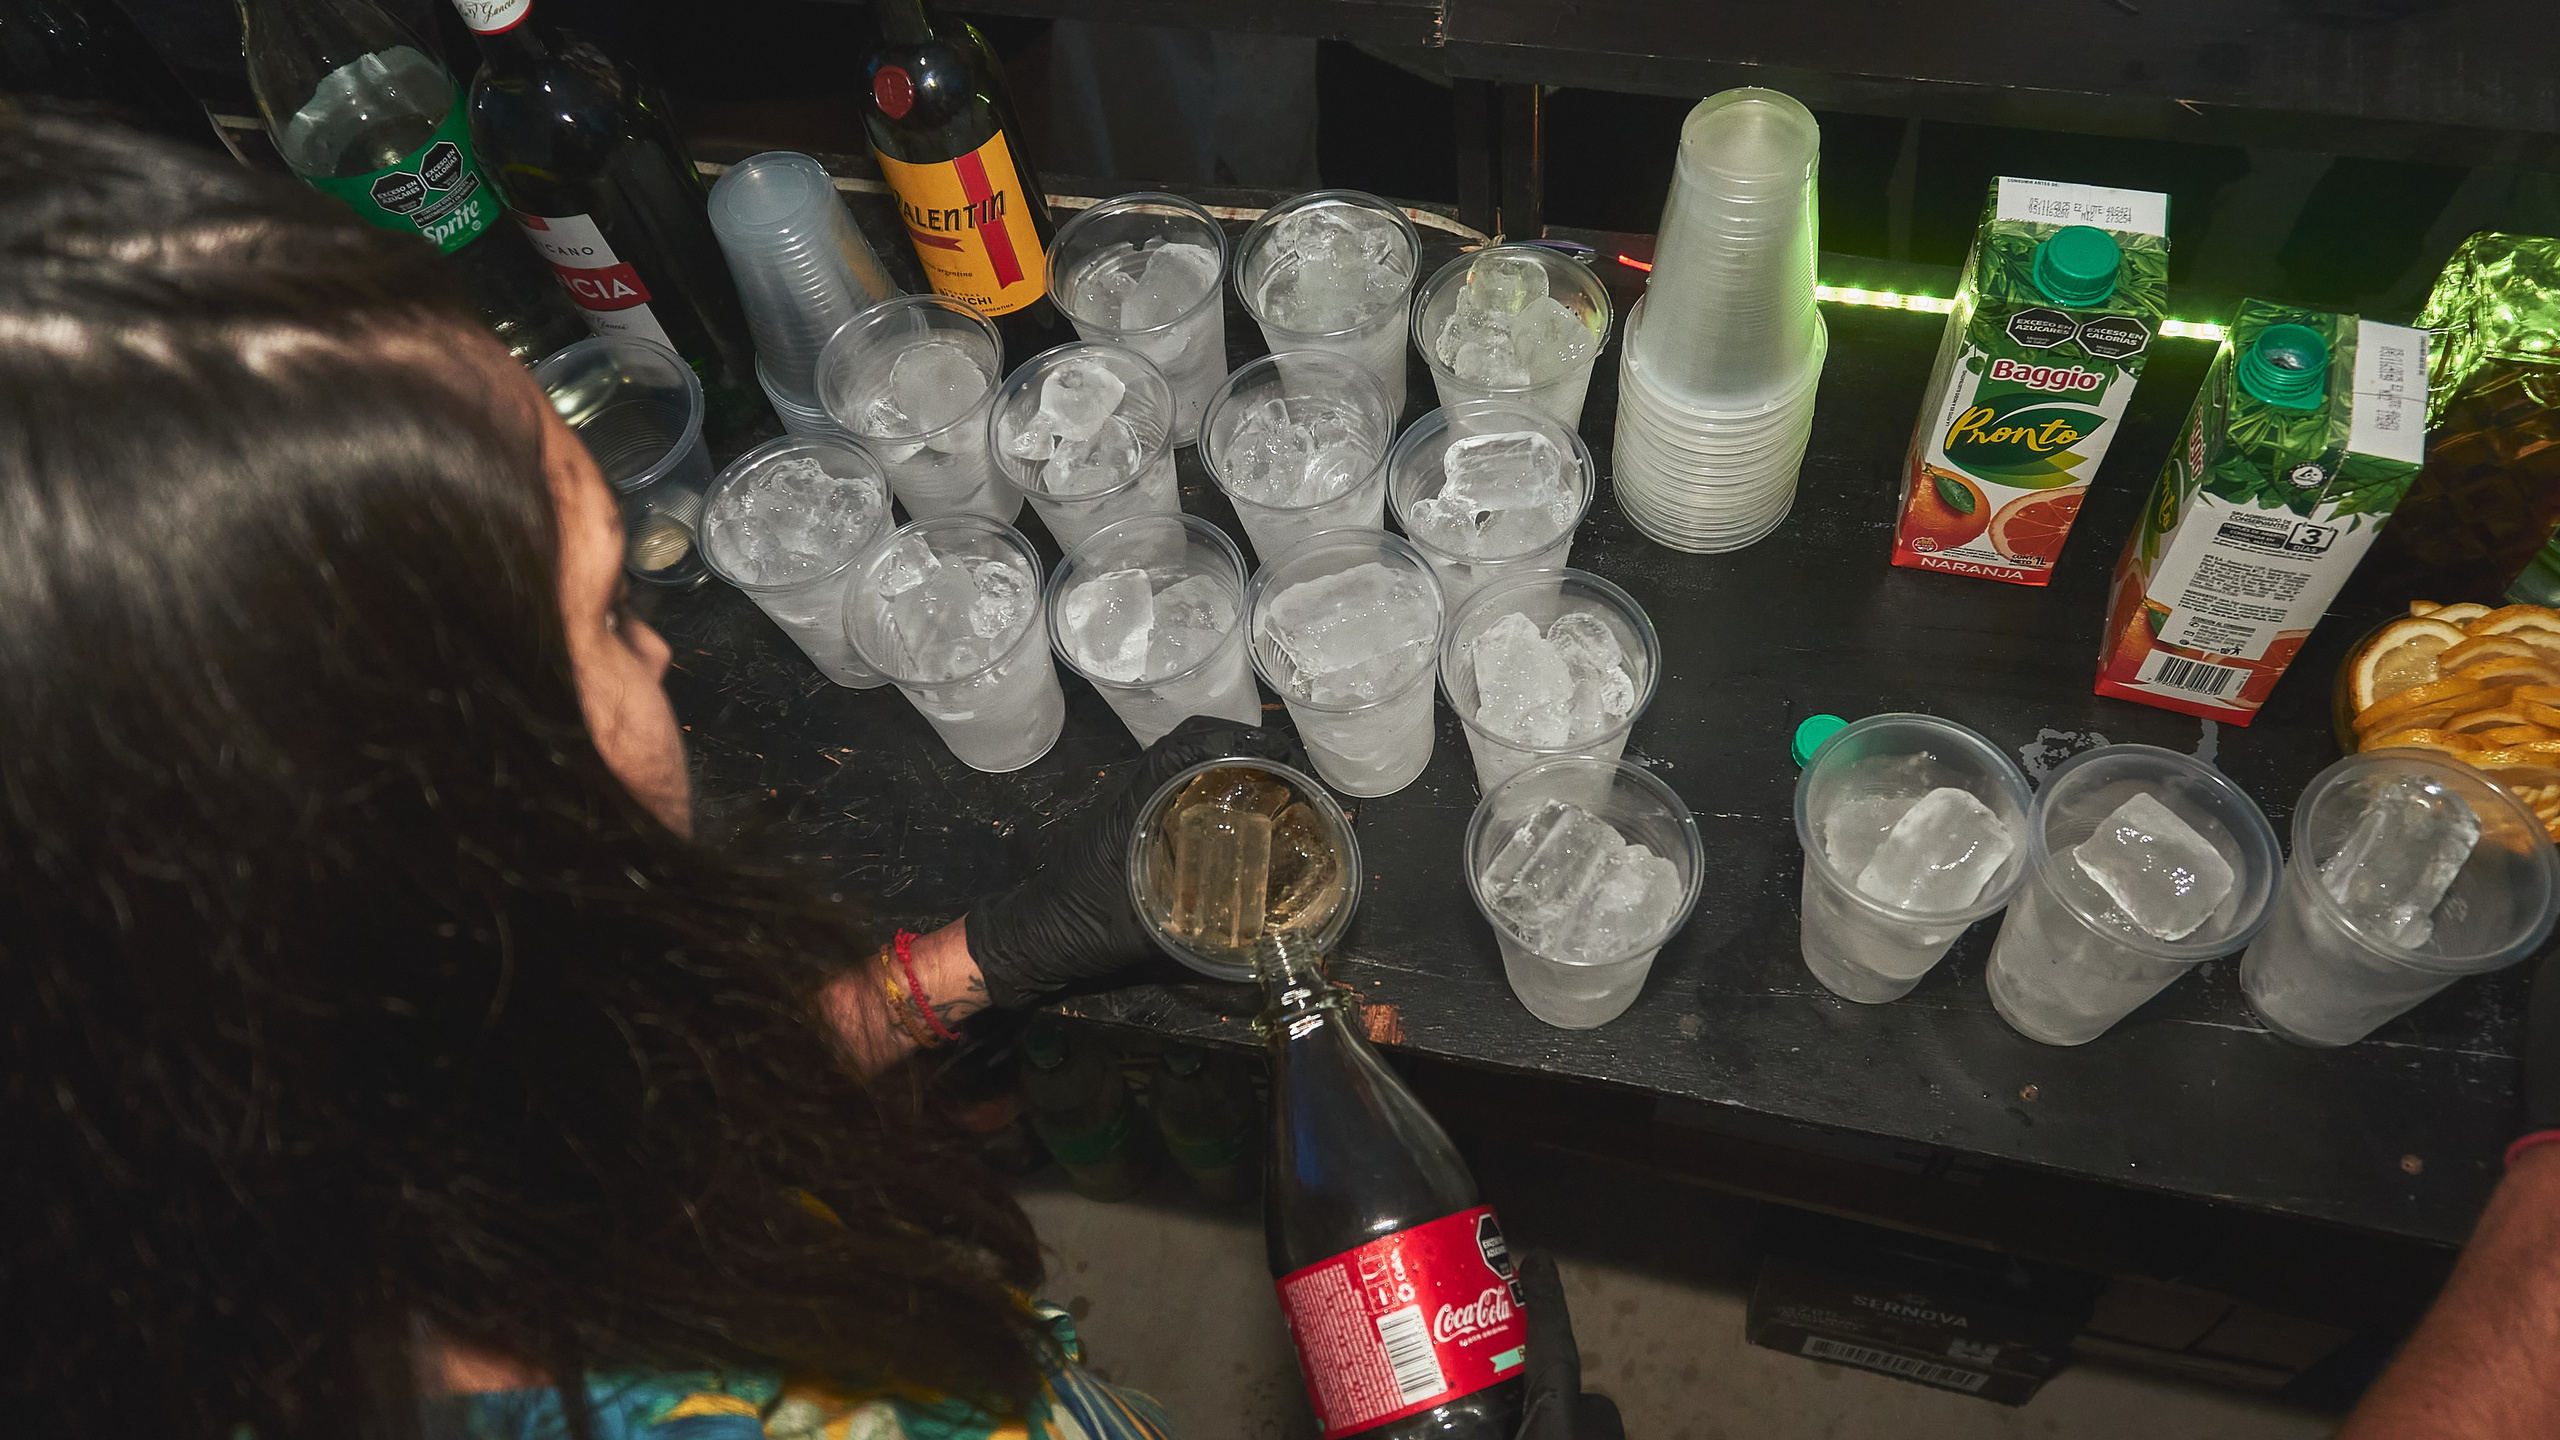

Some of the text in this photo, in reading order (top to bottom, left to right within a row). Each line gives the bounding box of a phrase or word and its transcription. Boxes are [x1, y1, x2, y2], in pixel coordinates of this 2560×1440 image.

[425, 148, 456, 178] EXCESO EN
[377, 180, 418, 199] EXCESO EN
[422, 200, 480, 245] Sprite
[937, 267, 973, 279] argentino
[554, 272, 638, 299] NCIA
[981, 302, 1014, 313] ARGENTINA
[2016, 318, 2073, 331] EXCESO EN
[2086, 326, 2144, 341] EXCESO EN
[2086, 331, 2138, 346] CALORÍAS
[1993, 360, 2098, 390] Baggio
[1944, 405, 2087, 452] Pronto
[2229, 514, 2290, 531] CONSERVANTES
[2245, 512, 2282, 523] AGREGADO
[2300, 529, 2323, 546] 3
[2293, 544, 2318, 554] DÍAS
[1920, 557, 2024, 580] NARANJA
[2035, 556, 2047, 565] 1L
[1433, 1286, 1511, 1343] Coca-Cola
[1852, 1295, 1969, 1329] SERNOVA
